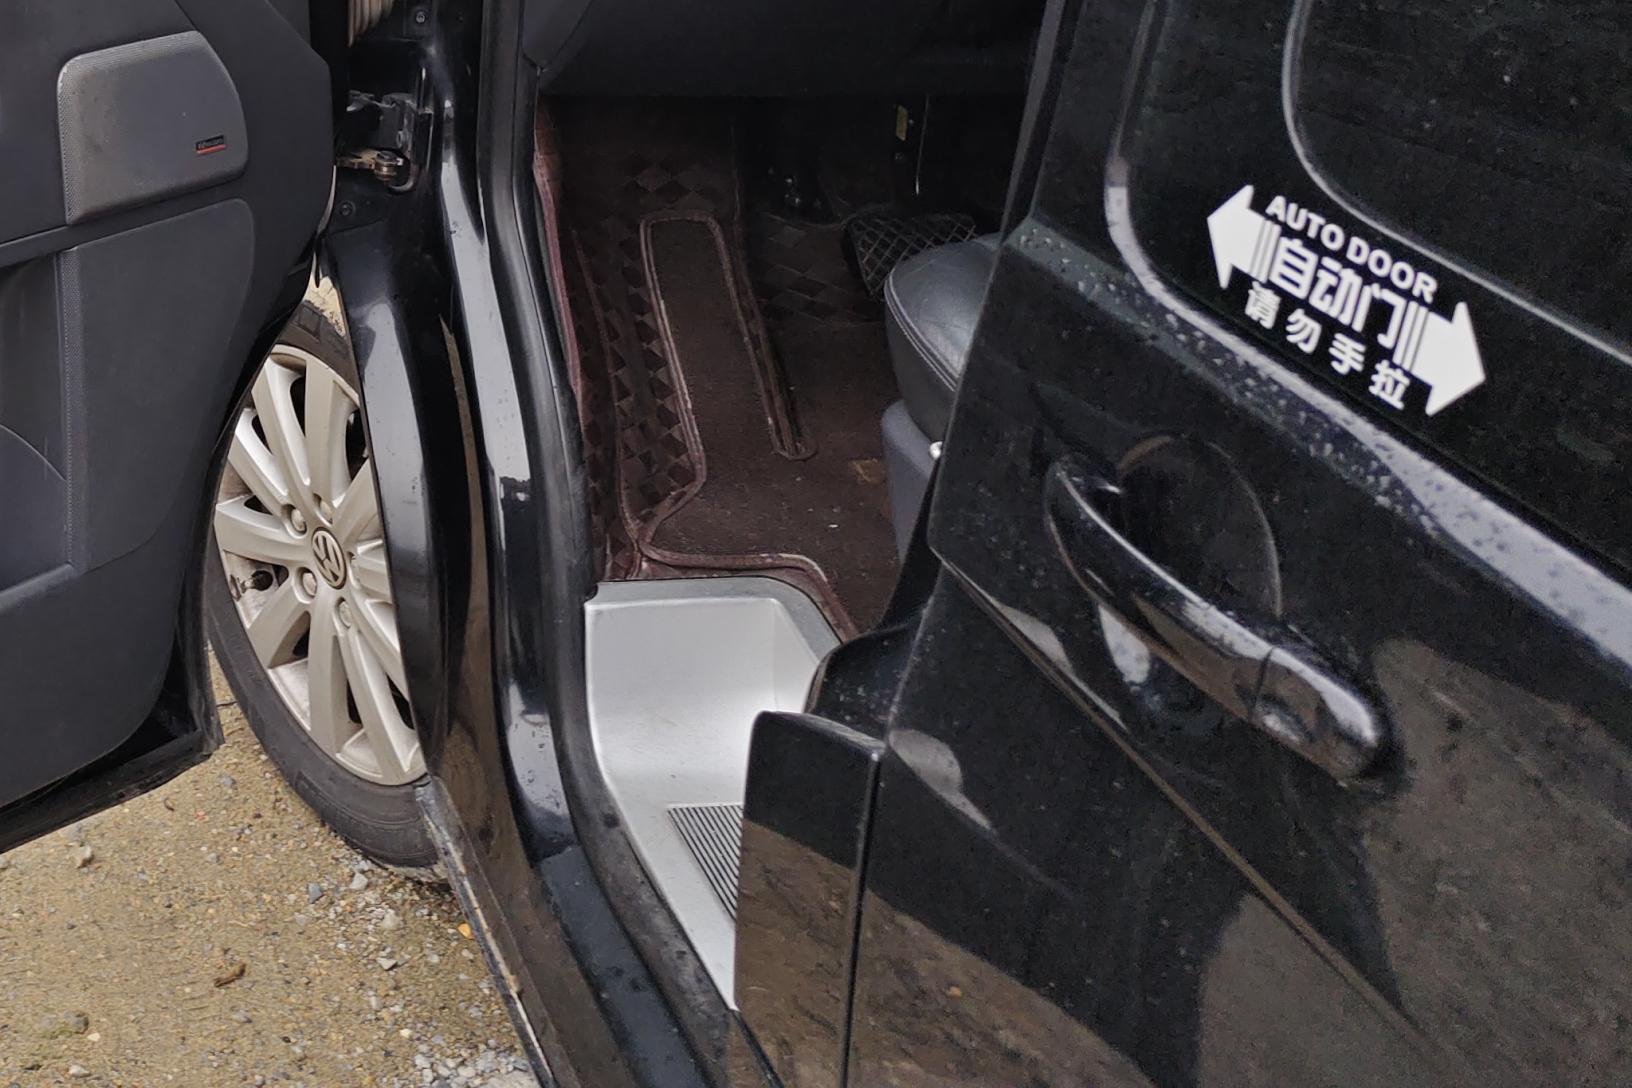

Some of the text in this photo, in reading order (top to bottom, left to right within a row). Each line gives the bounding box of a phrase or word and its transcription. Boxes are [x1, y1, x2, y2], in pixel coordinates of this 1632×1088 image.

[1265, 195, 1438, 303] AUTO DOOR
[1268, 237, 1407, 349] 自动门
[1245, 281, 1410, 410] 请勿手拉
